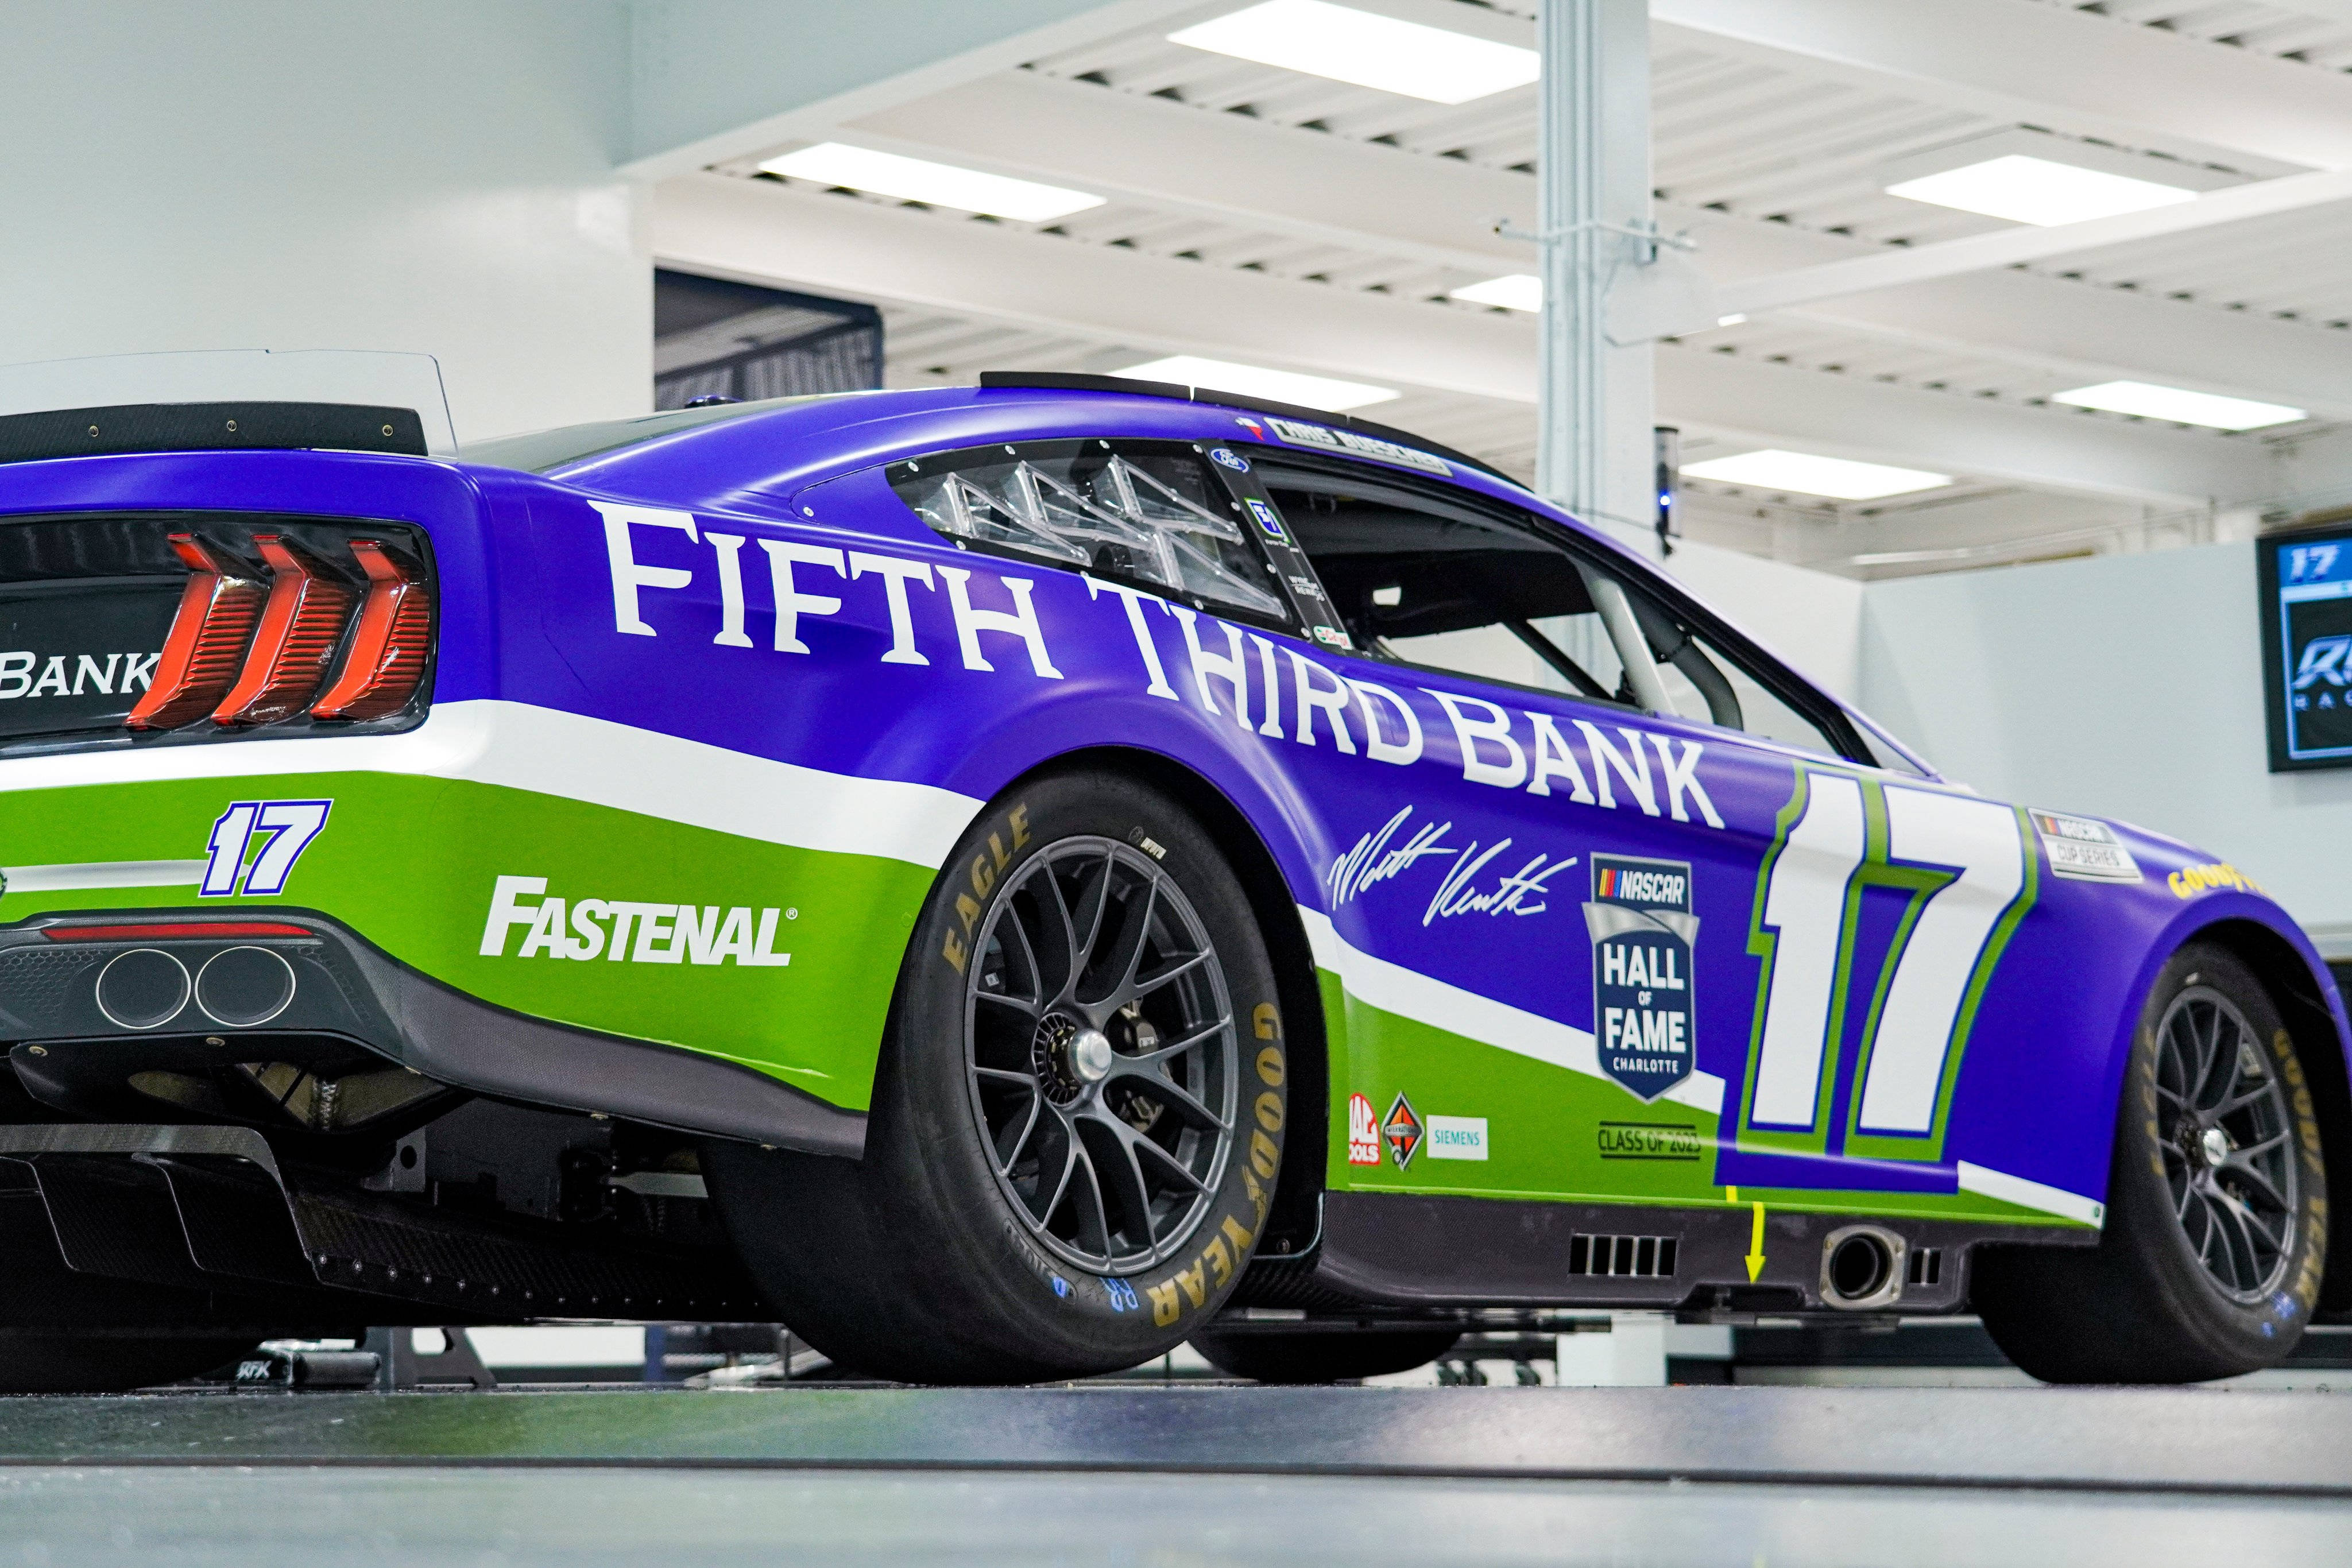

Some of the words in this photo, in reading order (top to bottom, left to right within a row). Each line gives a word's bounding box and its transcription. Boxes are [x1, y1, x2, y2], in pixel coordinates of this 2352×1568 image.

[2289, 545, 2341, 582] 17
[0, 651, 162, 699] BANK
[586, 500, 1065, 680] FIFTH
[1082, 576, 1424, 766] THIRD
[1418, 687, 1725, 828] BANK
[199, 799, 334, 897] 17
[942, 803, 1031, 975] EAGLE
[1619, 870, 1685, 905] NASCAR
[1603, 942, 1685, 990] HALL
[1746, 767, 2034, 1144] 17
[1638, 990, 1653, 1006] OF
[1604, 1006, 1686, 1054] FAME
[1612, 1056, 1678, 1074] CHARLOTTE
[1349, 1095, 1379, 1143] AC
[1434, 1129, 1480, 1146] SIEMENS
[1597, 1129, 1644, 1152] CLASS
